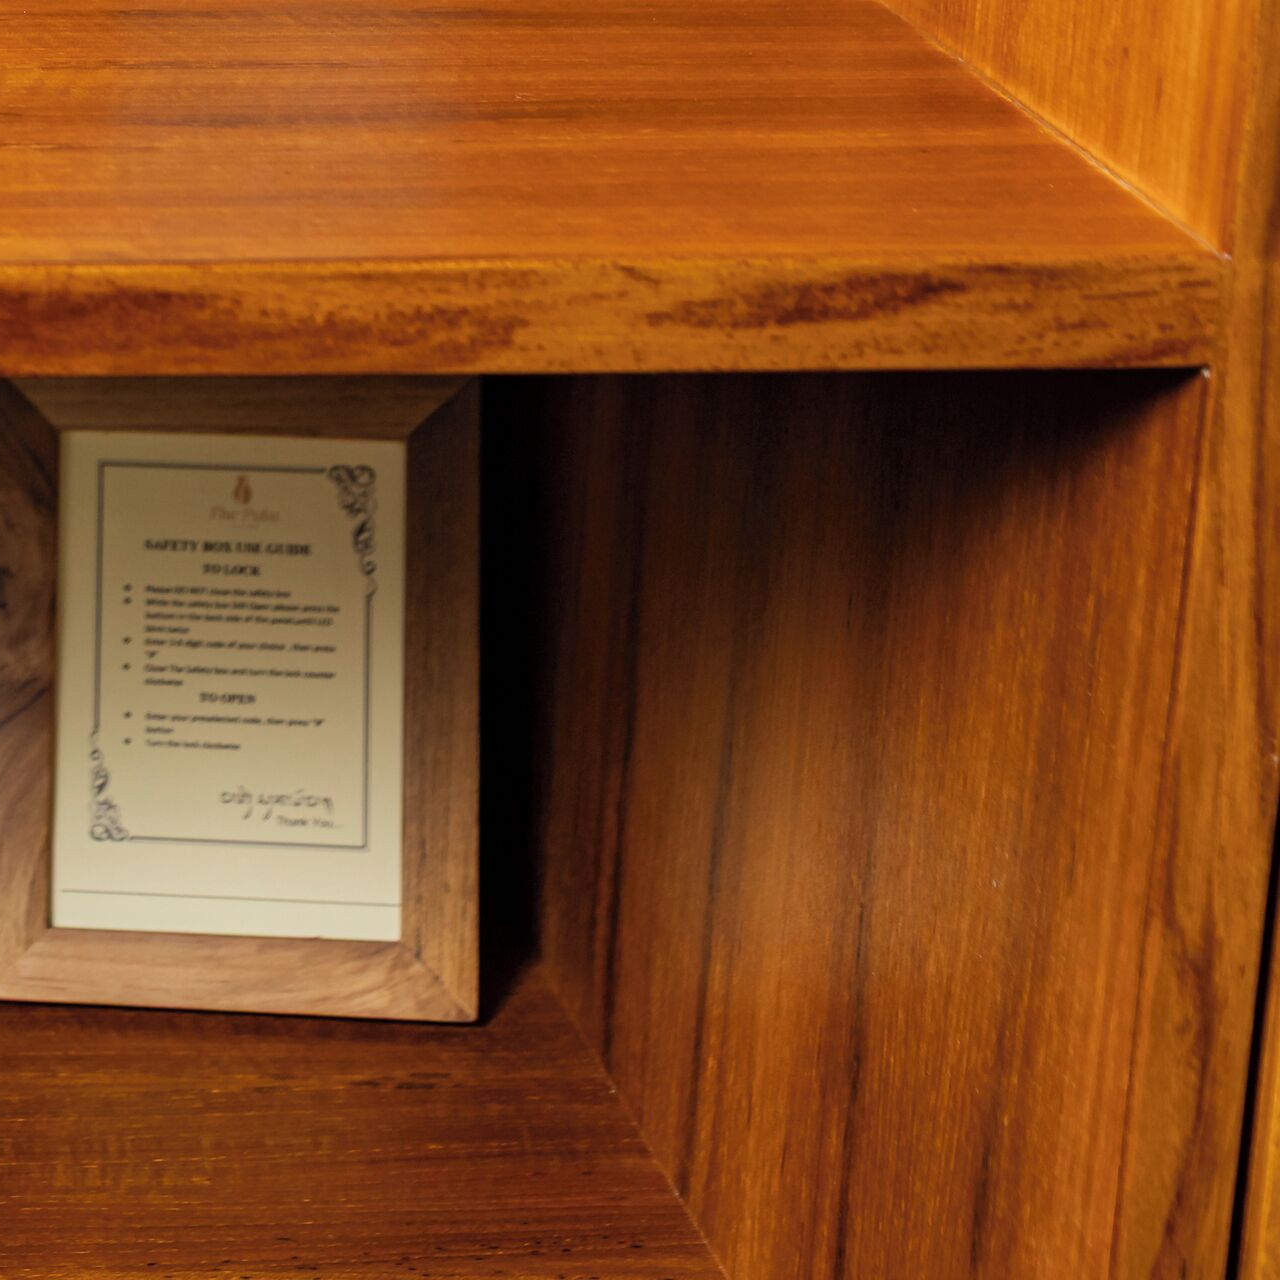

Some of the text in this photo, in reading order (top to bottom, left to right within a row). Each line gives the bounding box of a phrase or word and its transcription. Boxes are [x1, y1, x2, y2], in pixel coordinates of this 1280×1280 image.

[144, 539, 197, 552] SAFETY
[201, 541, 232, 554] BOX
[265, 543, 312, 556] GUIDE
[202, 563, 261, 577] TO LOCK
[200, 692, 256, 705] TO OPEN
